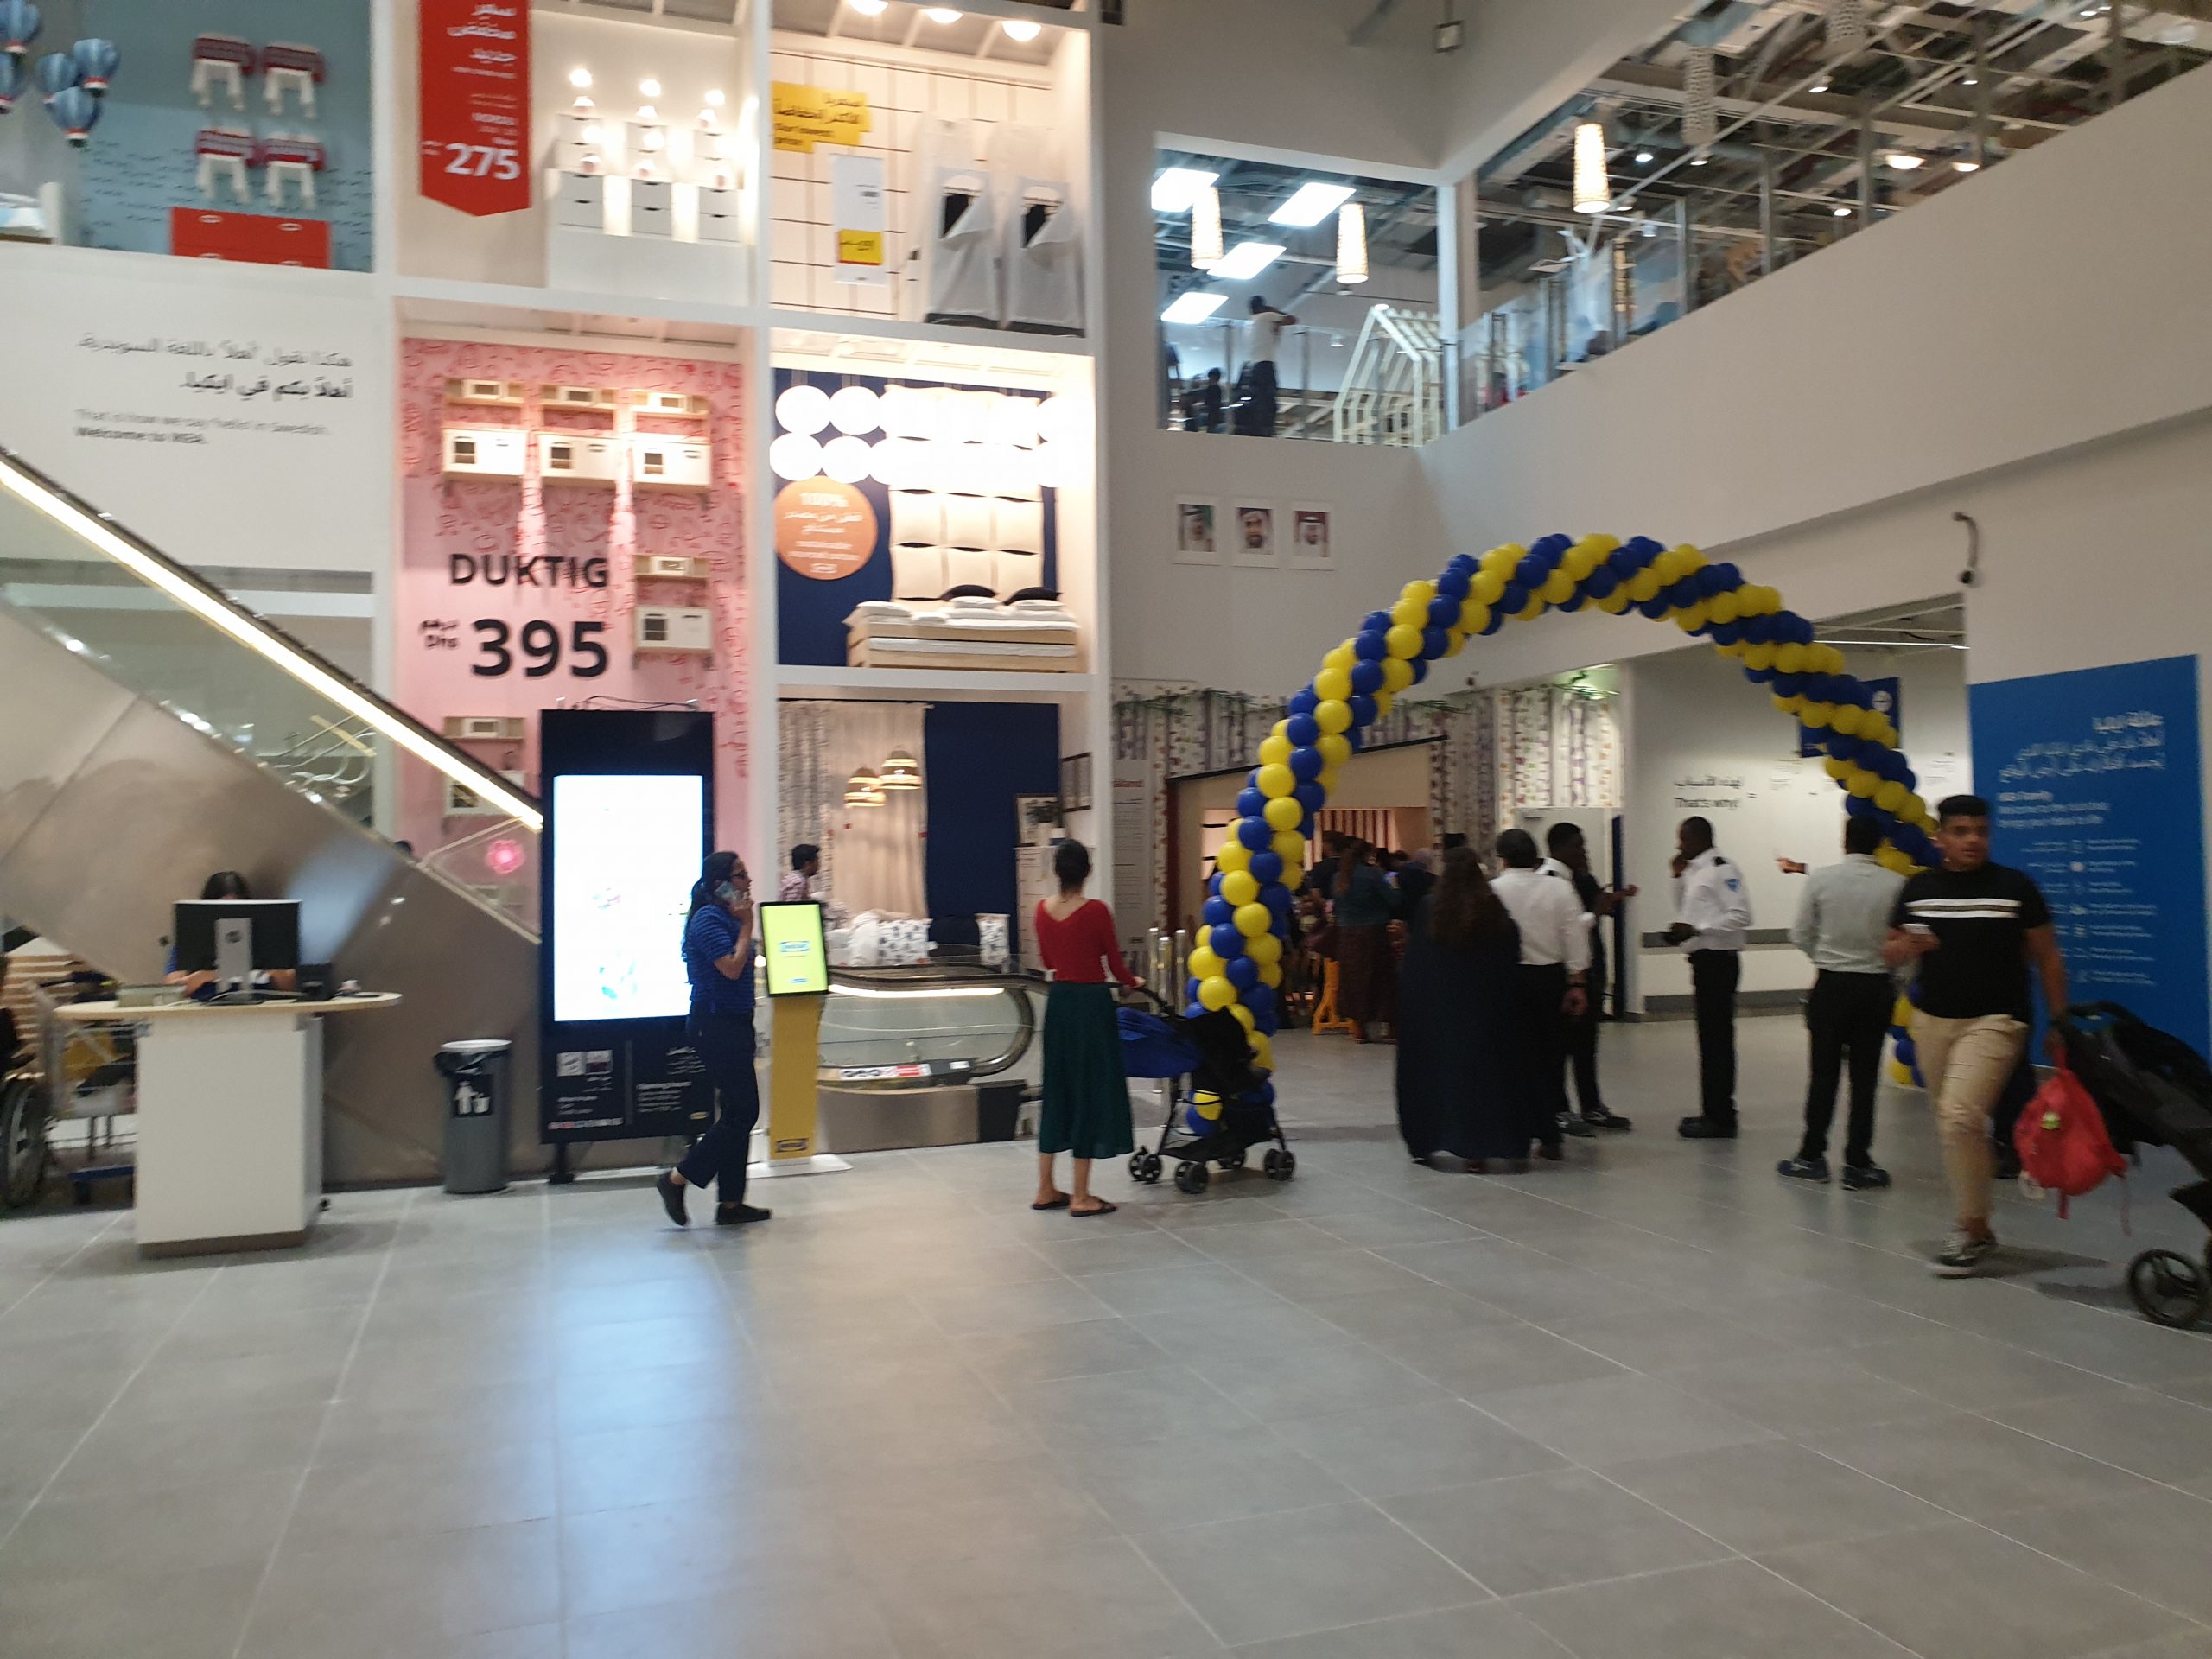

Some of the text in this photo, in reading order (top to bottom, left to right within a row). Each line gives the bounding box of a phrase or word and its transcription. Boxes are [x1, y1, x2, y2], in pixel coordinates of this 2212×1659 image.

[444, 142, 521, 180] 275
[448, 553, 609, 588] DUKTIG
[471, 618, 609, 678] 395
